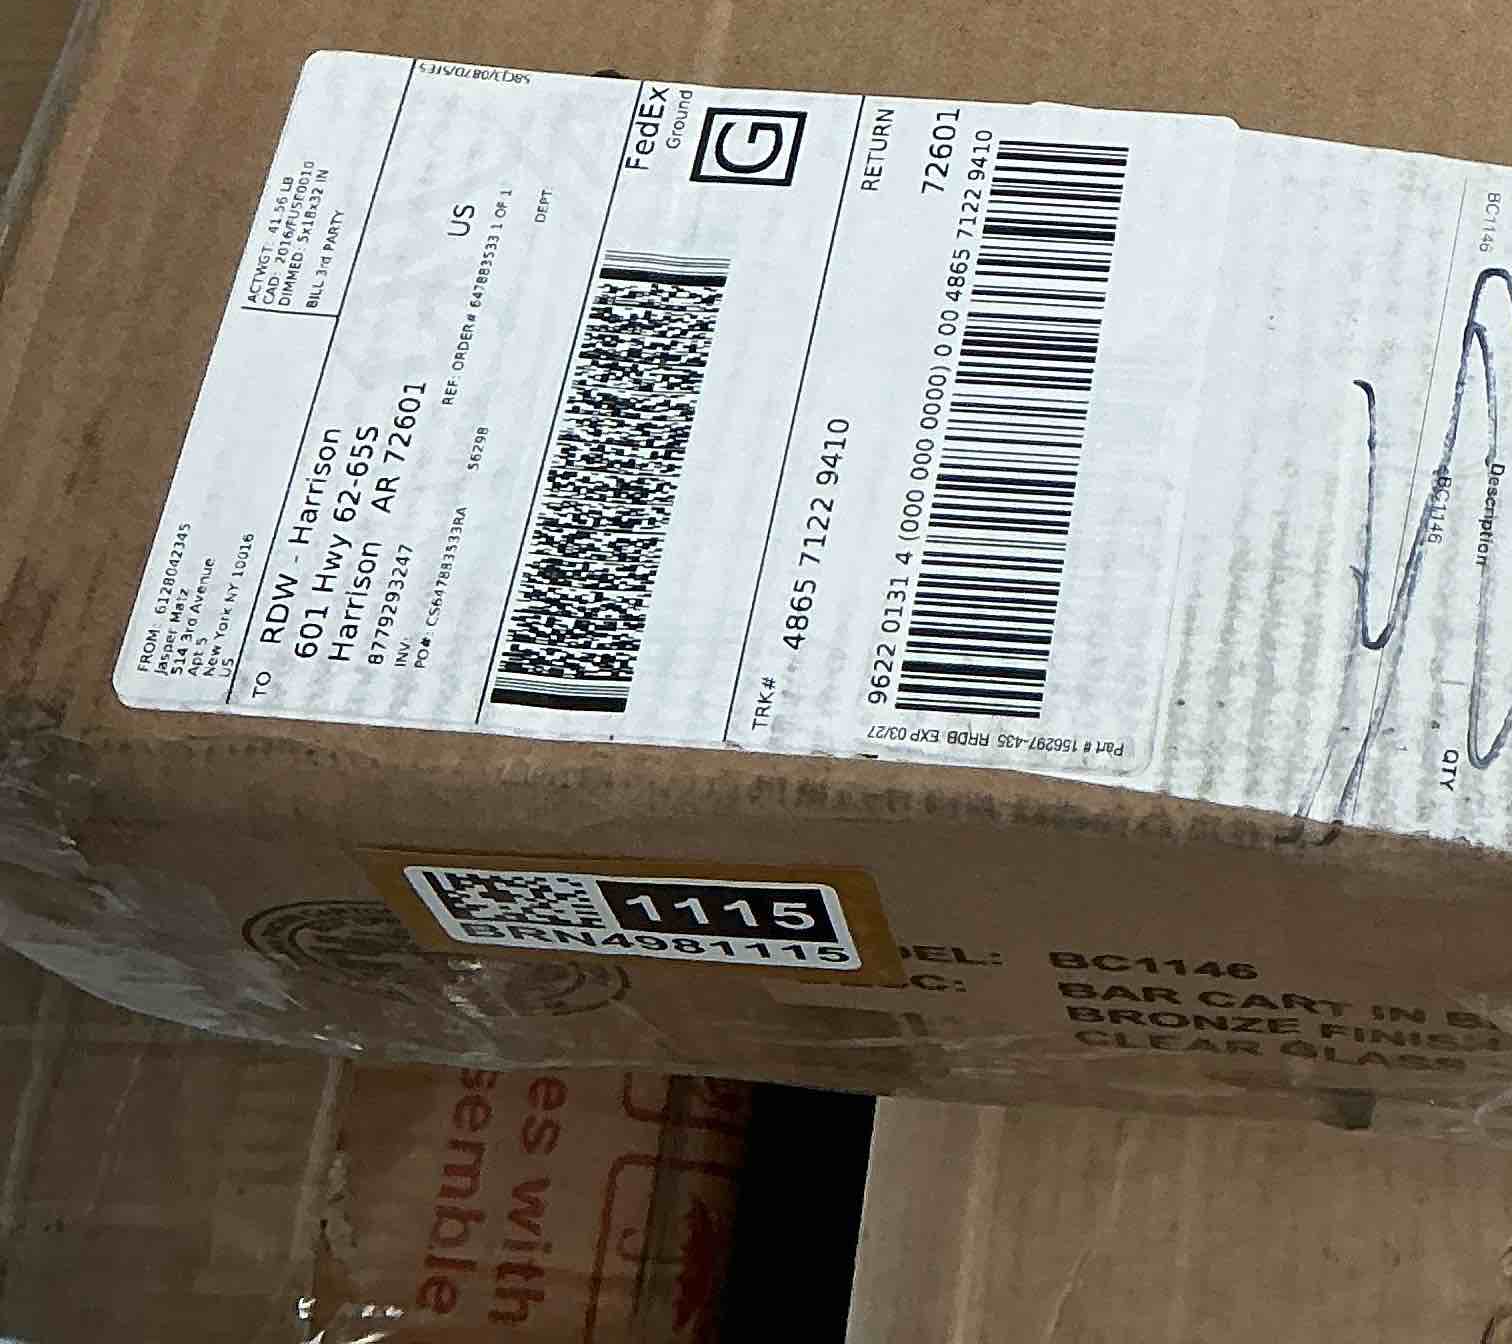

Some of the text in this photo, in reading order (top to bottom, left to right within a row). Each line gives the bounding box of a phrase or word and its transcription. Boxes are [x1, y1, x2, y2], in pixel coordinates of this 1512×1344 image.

[624, 86, 671, 171] FedEx
[665, 88, 694, 150] Ground
[714, 121, 784, 175] G
[860, 108, 896, 192] RETURN
[920, 107, 961, 195] 72601
[322, 209, 345, 253] PARTY
[446, 203, 477, 238] US
[1478, 191, 1502, 254] BC1146
[867, 128, 994, 705] 9622 0131 4 (000 000 0000) 0 00 4865 7122 9410
[251, 427, 342, 699] TO RDW Harrison
[293, 424, 380, 660] 601 Hwy 62-65S
[327, 380, 428, 663] Harrison AR 72601
[170, 557, 215, 676] 514 Avenue
[202, 644, 223, 678] New
[231, 532, 255, 578] 10016
[367, 543, 414, 666] 8779293247
[751, 417, 851, 732] TRK# 4865 7122 9410
[1438, 461, 1506, 793] Description QTY
[866, 724, 907, 741] 03/27
[909, 729, 940, 745] EXP
[464, 920, 853, 966] BRN4981115
[624, 894, 817, 932] 1115
[1048, 948, 1261, 983] BC1146
[1057, 978, 1178, 1010] BAR
[1194, 989, 1353, 1020] CART
[1066, 1005, 1303, 1037] BRONZE
[489, 1176, 552, 1324] with
